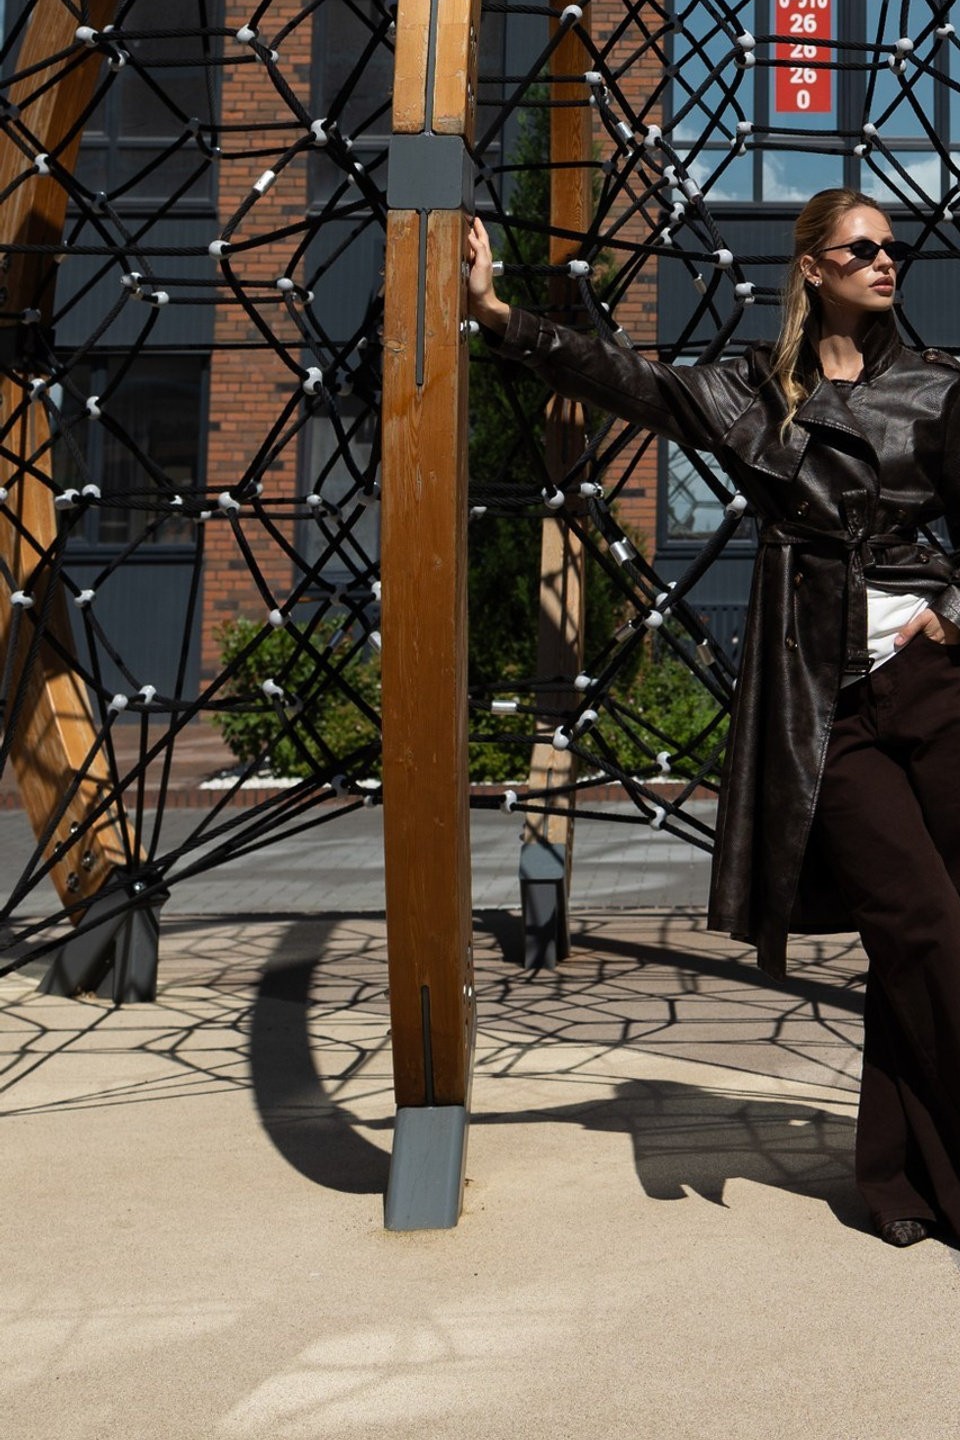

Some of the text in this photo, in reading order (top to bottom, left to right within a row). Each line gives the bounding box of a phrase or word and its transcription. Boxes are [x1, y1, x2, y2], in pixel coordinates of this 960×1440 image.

[789, 13, 817, 33] 26
[789, 43, 817, 58] 26
[789, 66, 817, 84] 26
[796, 89, 811, 109] 0
